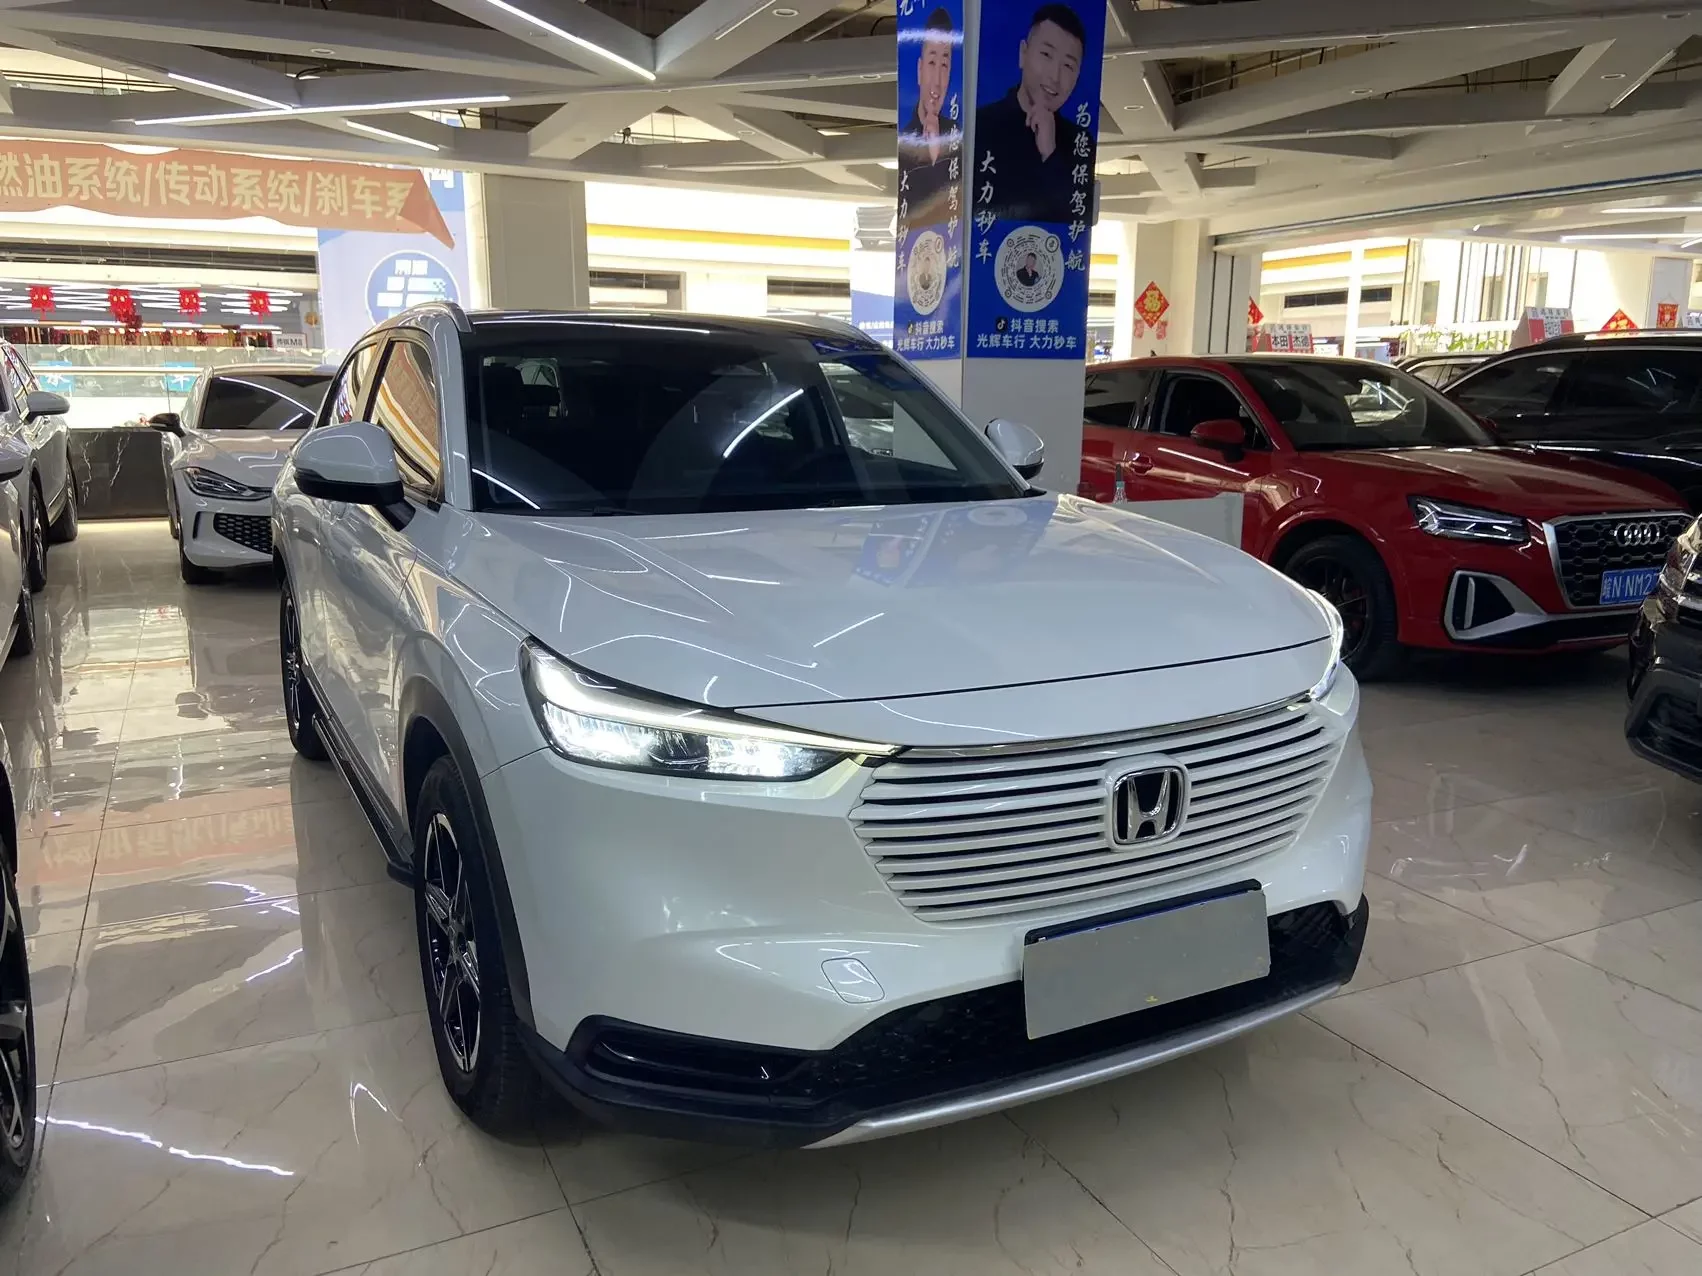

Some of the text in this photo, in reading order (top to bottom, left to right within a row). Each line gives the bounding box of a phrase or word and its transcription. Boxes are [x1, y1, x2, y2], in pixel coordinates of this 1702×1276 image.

[1065, 102, 1091, 271] 为您保驾护航
[974, 150, 997, 265] 大力秒车
[915, 320, 944, 336] 抖音搜索
[1010, 319, 1059, 334] 抖音搜索
[897, 337, 924, 351] 光辉车行
[925, 335, 956, 350] 大力秒车
[976, 334, 1077, 349] 光辉车行 大力秒车
